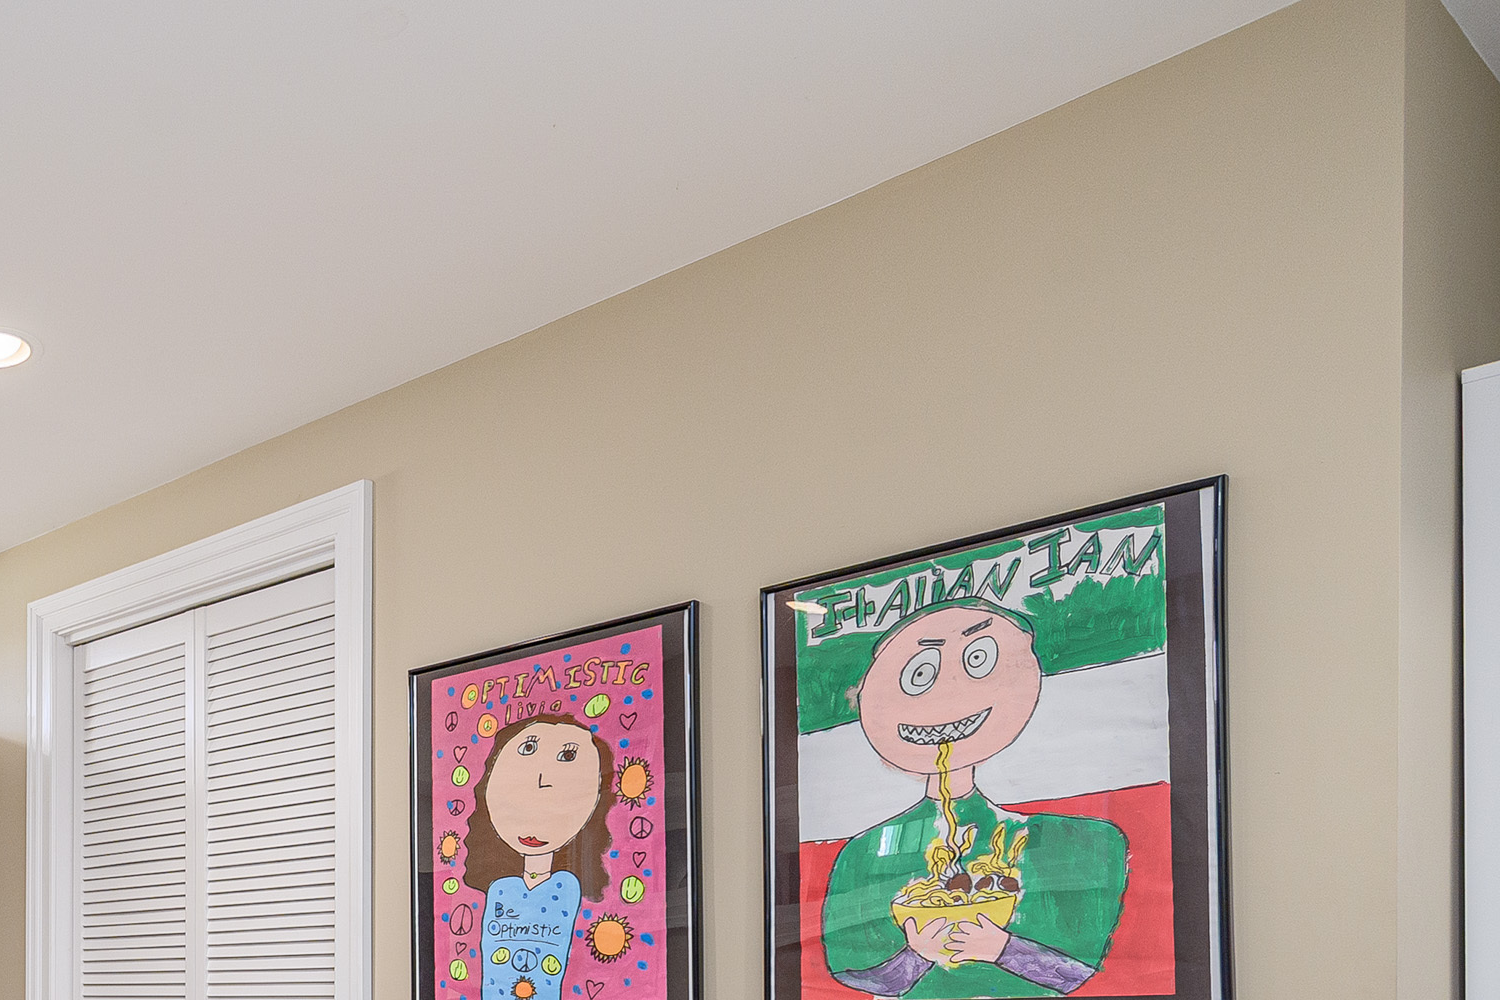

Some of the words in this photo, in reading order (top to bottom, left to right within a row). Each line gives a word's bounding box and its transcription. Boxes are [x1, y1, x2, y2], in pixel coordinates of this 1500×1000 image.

[461, 657, 650, 709] OPTIMISTIC
[494, 902, 520, 918] Be
[487, 920, 561, 938] Optimistic
